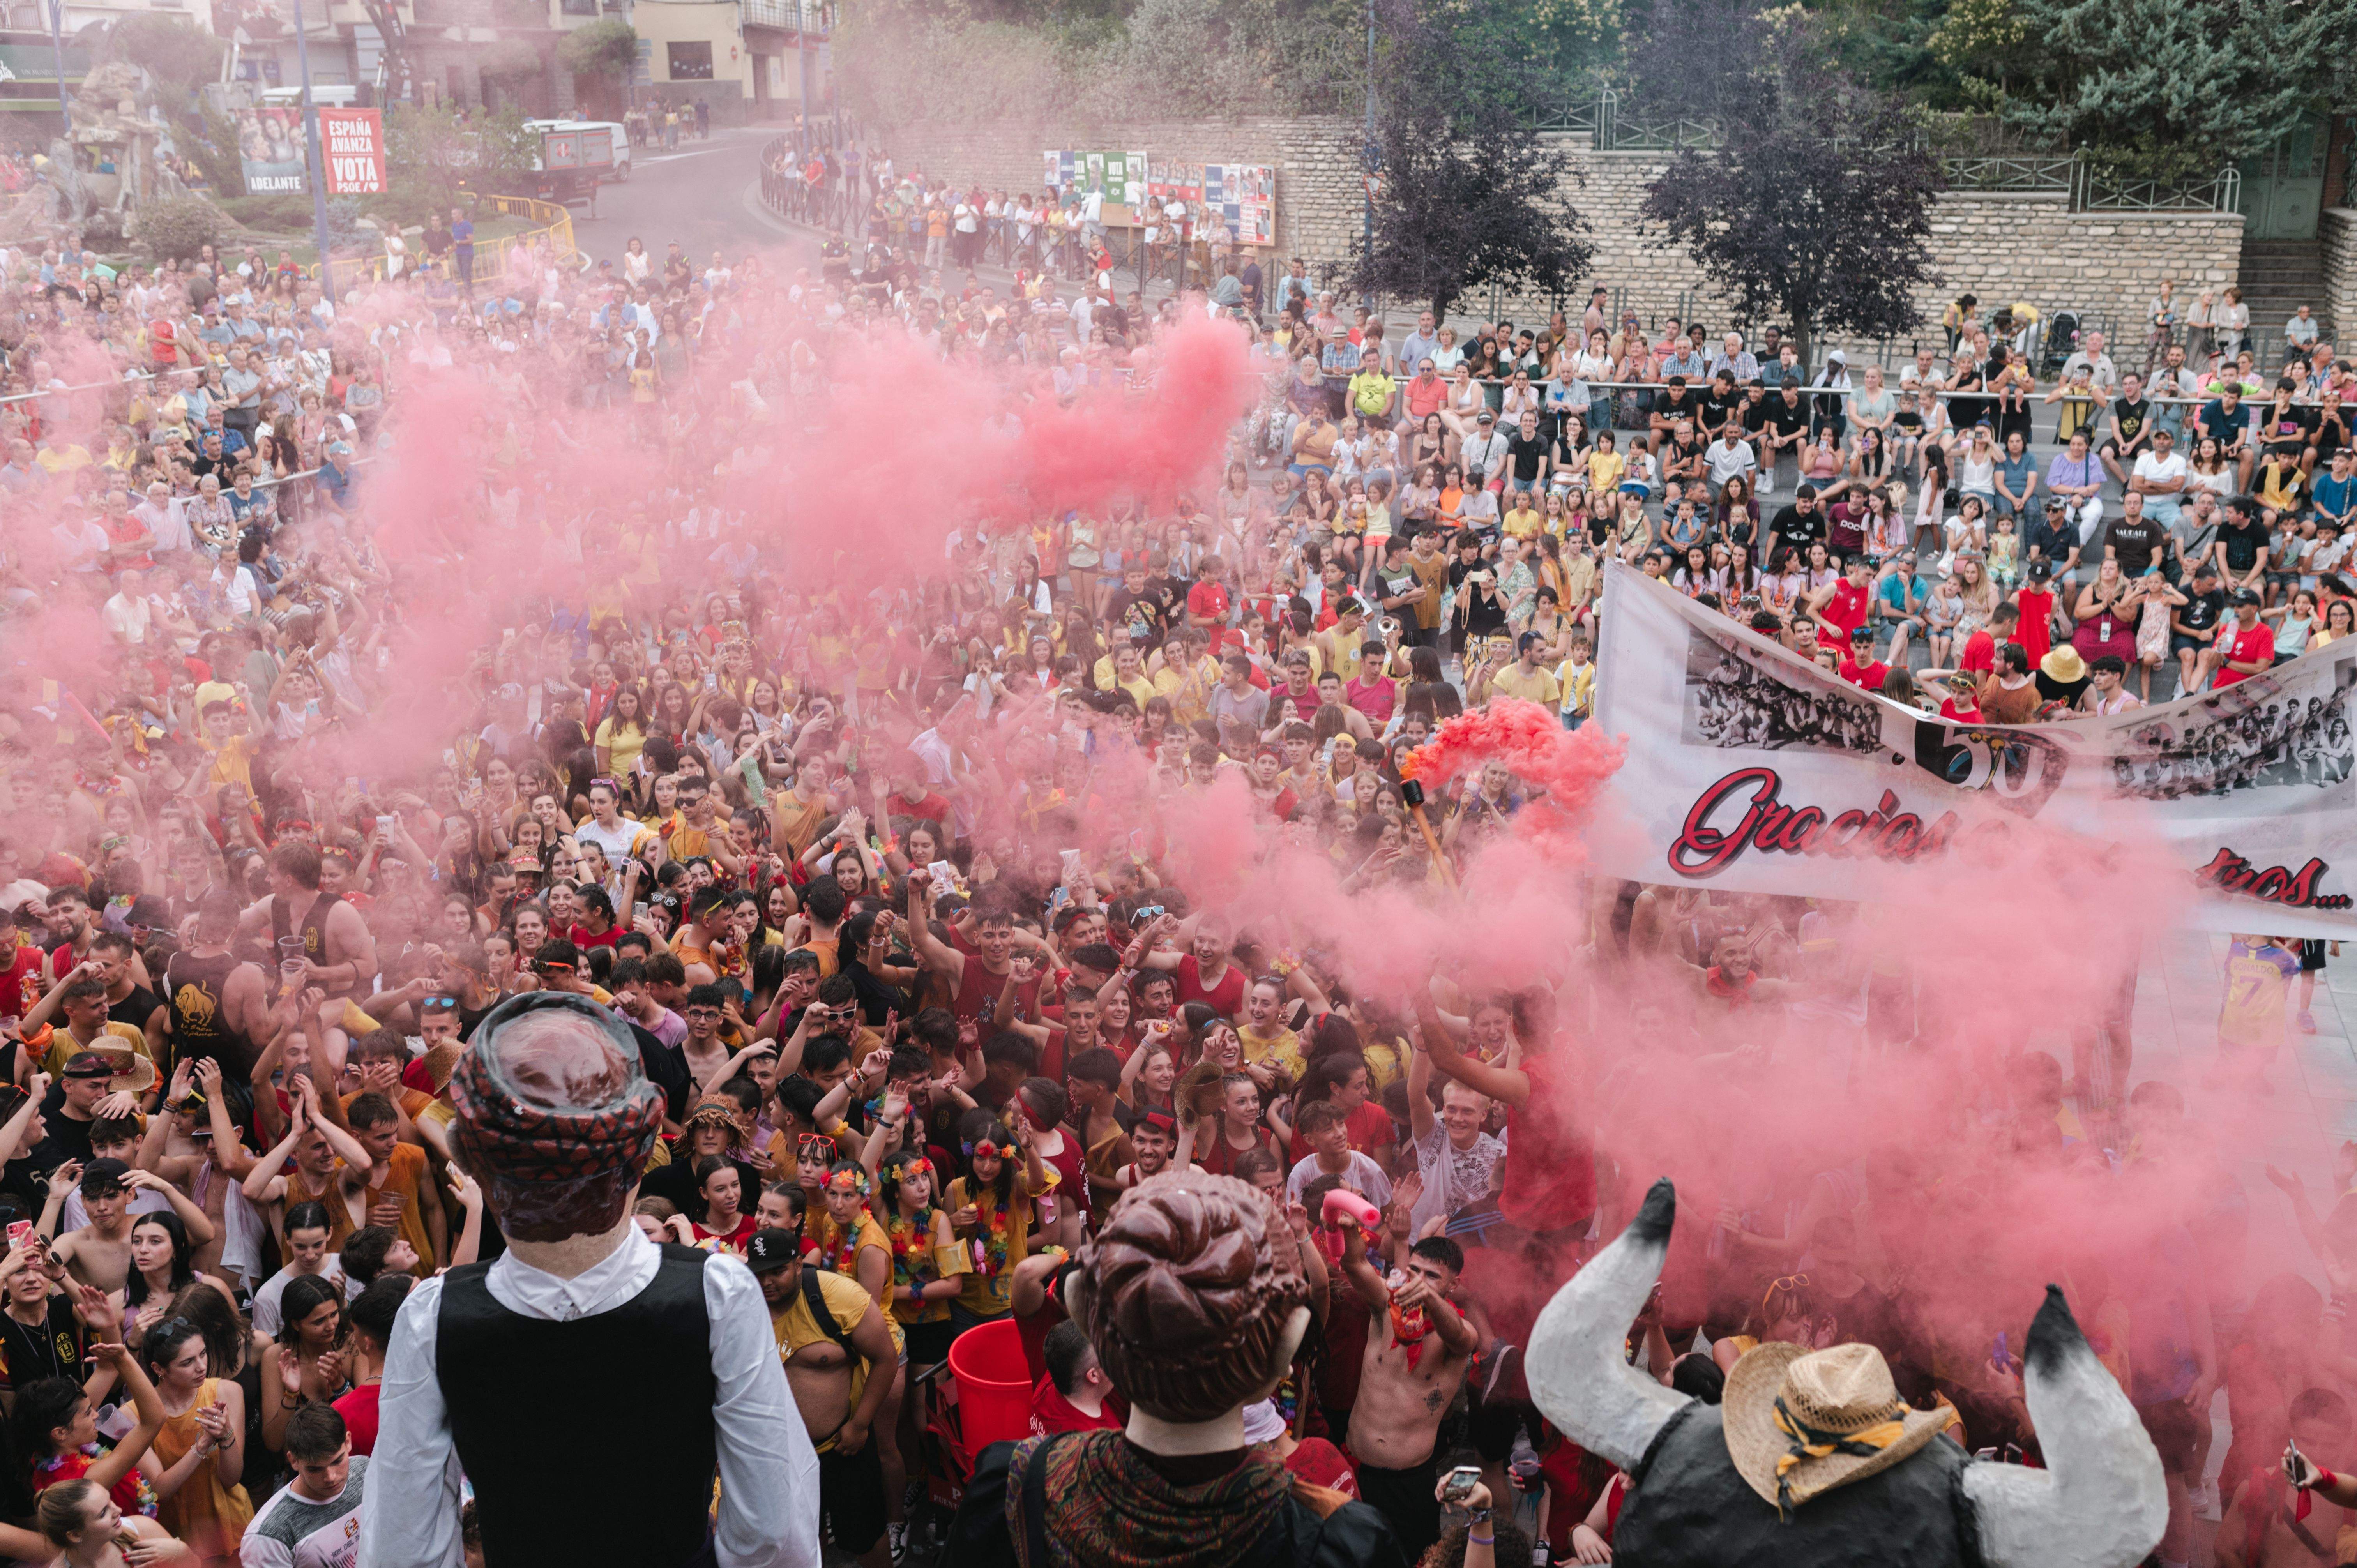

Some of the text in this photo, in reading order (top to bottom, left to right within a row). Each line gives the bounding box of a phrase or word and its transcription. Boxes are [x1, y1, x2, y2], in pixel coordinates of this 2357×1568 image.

[329, 117, 372, 136] ESPAÑA
[331, 137, 373, 152] AVANZA
[332, 157, 377, 181] VOTA
[1108, 162, 1123, 175] VOTA
[251, 177, 301, 190] ADELANTE
[337, 182, 361, 192] PSOE
[1668, 767, 1963, 878] Gracias
[2233, 962, 2274, 975] RONALDO
[2239, 975, 2264, 1008] 7
[934, 1494, 958, 1510] PUENT
